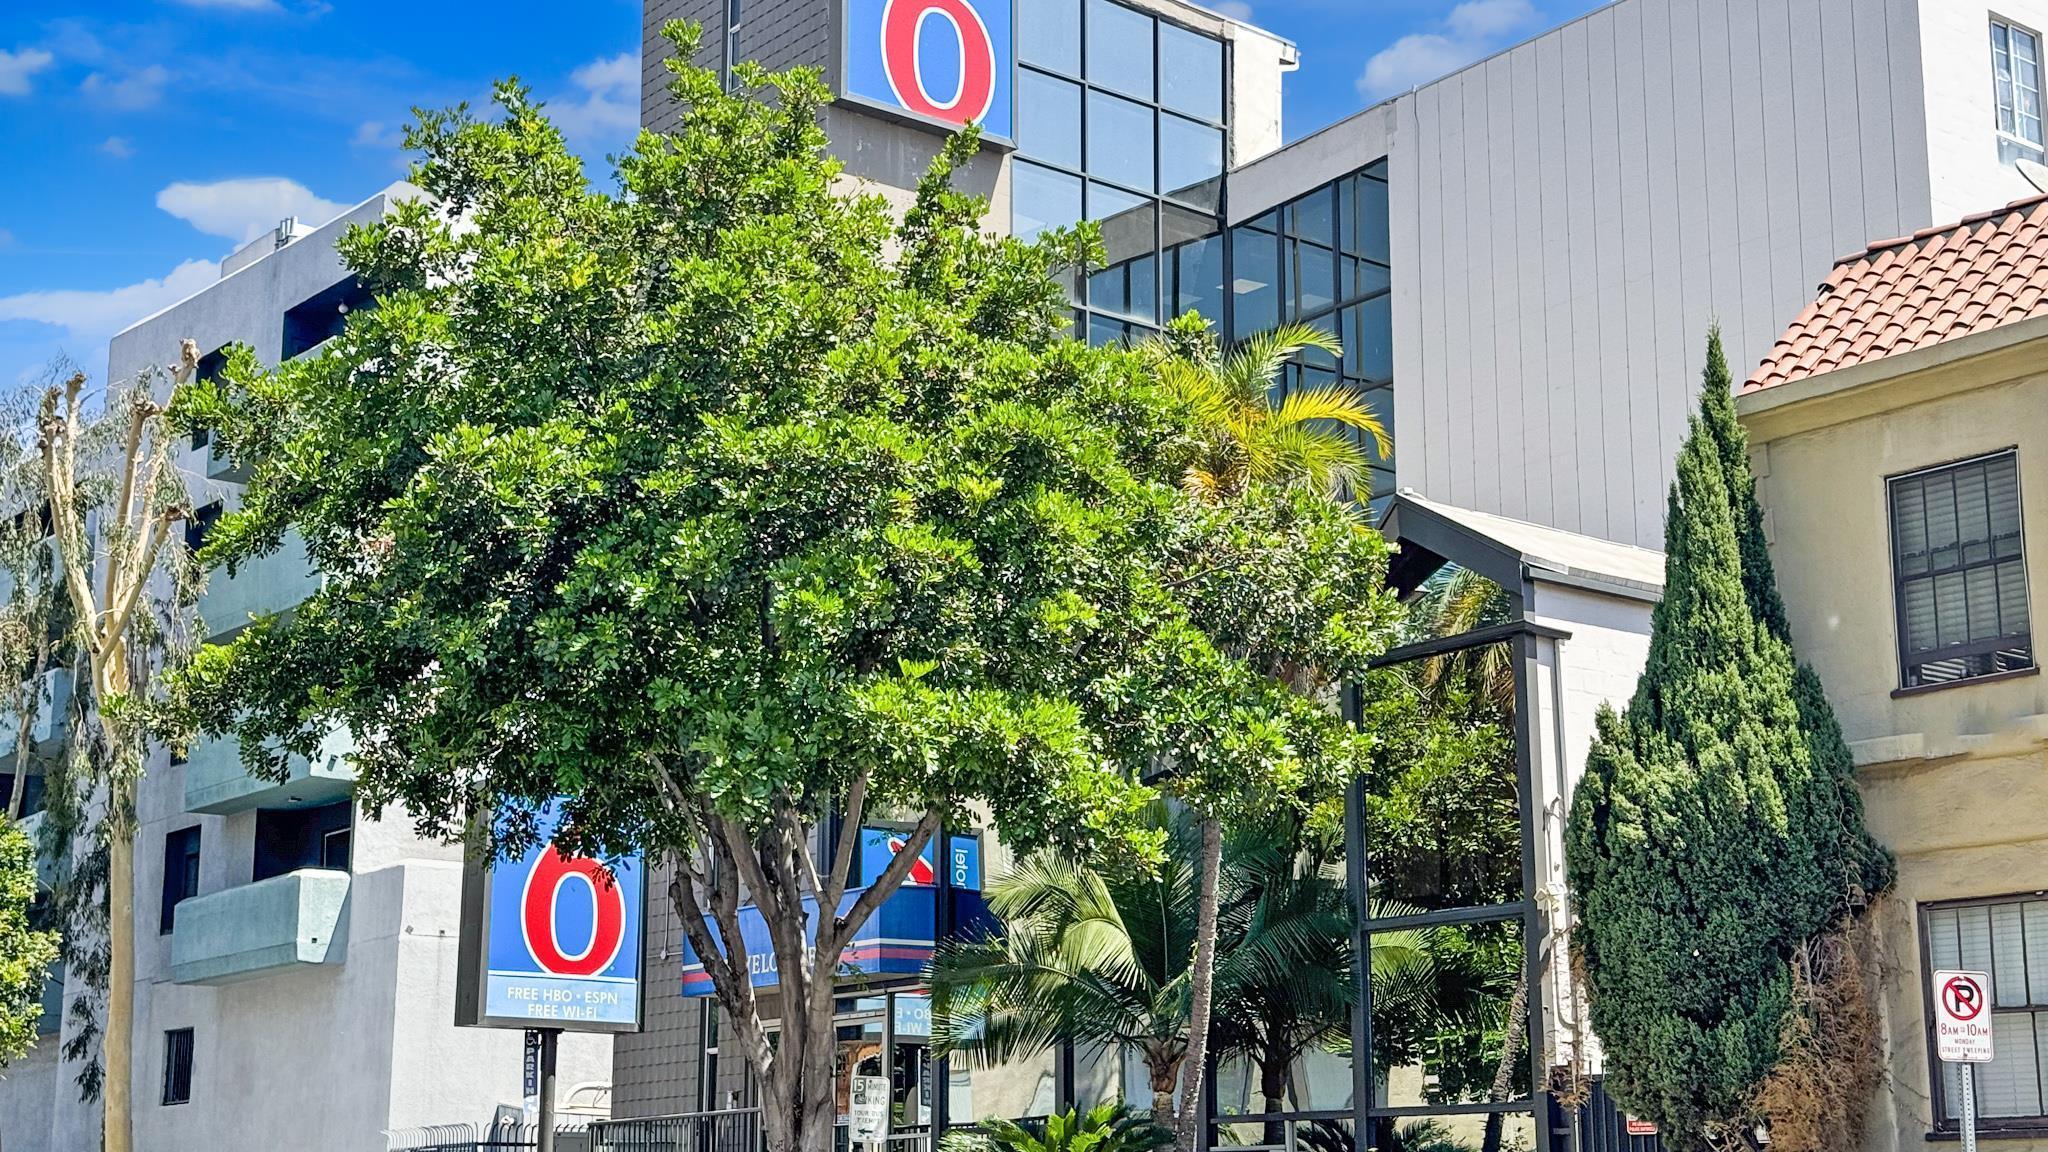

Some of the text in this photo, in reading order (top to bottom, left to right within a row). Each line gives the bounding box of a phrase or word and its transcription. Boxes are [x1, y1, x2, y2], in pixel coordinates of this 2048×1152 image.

[507, 986, 618, 1005] FREE HBO ESPN
[528, 1003, 598, 1019] FREE WI-FI
[1940, 1023, 1959, 1035] 8AM
[1967, 1024, 1988, 1036] 10AM
[853, 1079, 864, 1092] 15
